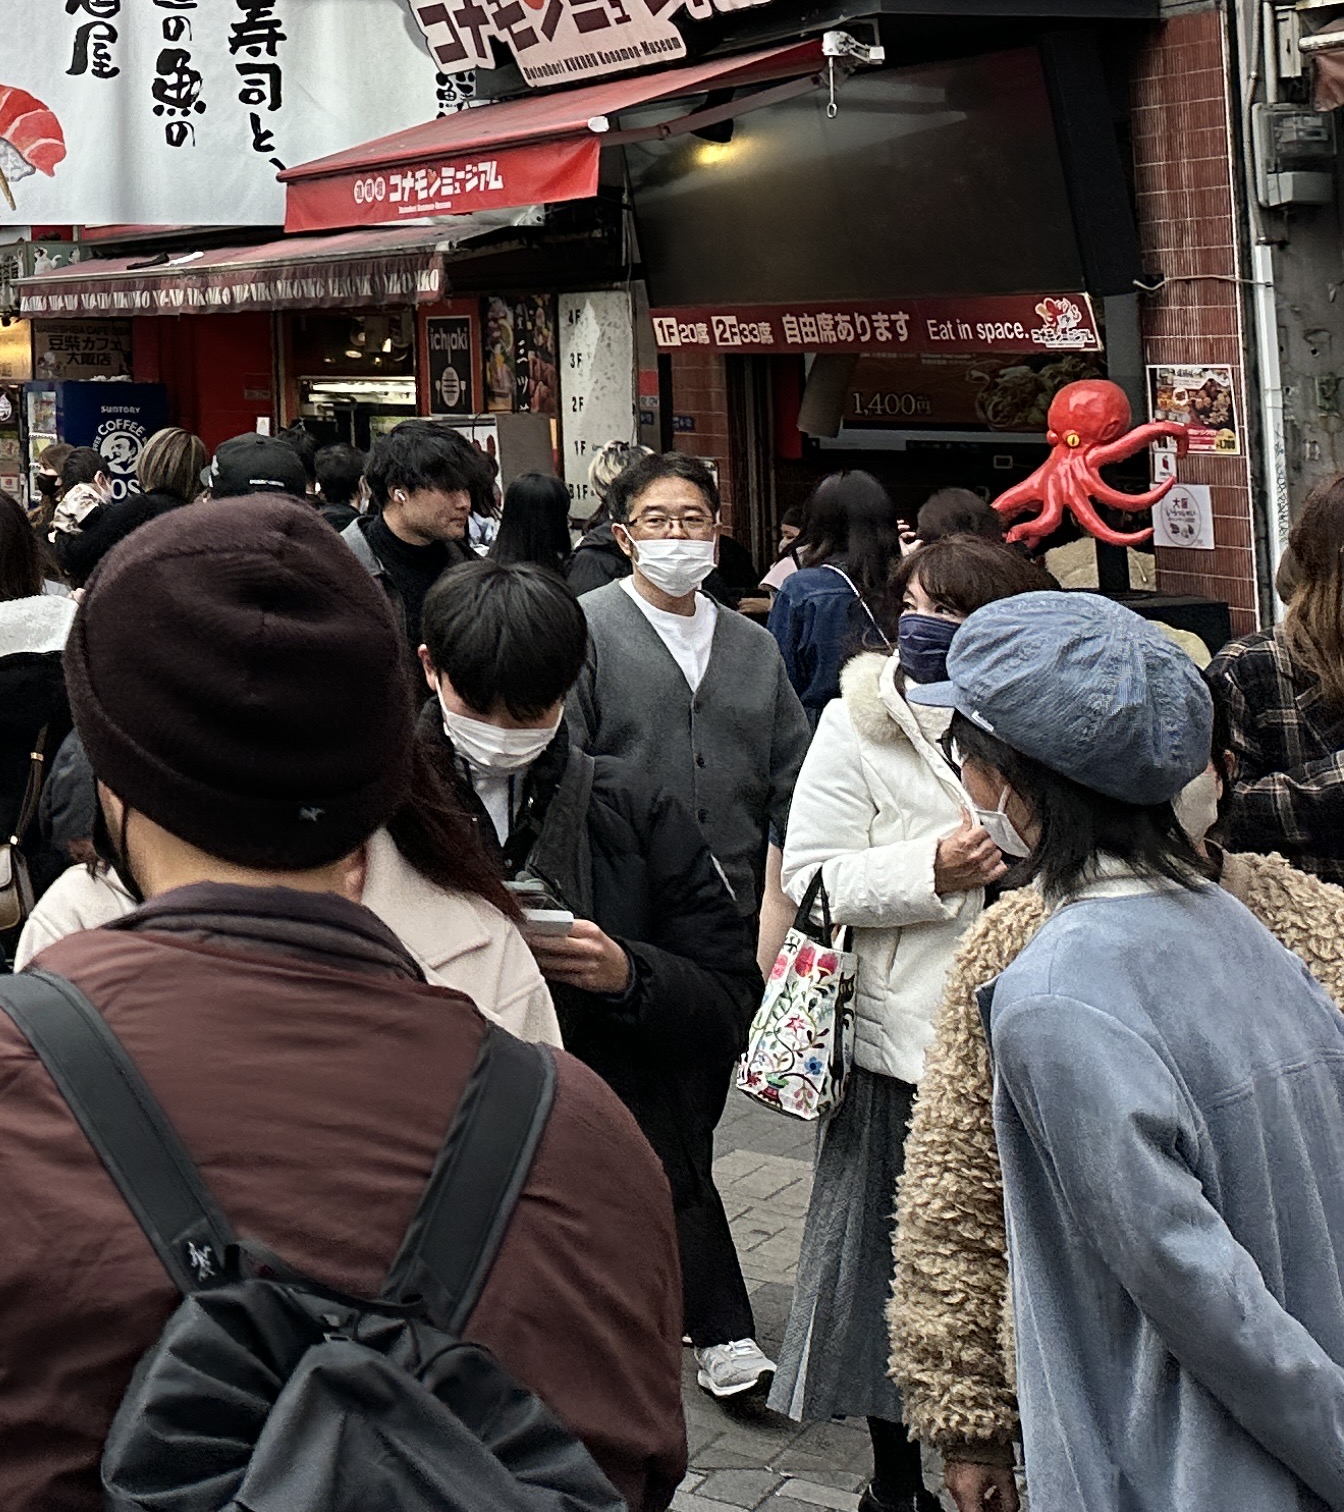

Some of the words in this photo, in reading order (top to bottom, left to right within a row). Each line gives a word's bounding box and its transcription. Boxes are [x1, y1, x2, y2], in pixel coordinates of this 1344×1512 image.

[389, 160, 504, 203] コナモンミュージアム
[568, 309, 582, 324] 4F
[782, 311, 910, 345] 自由席あります
[927, 318, 955, 342] Eat
[957, 318, 973, 341] in
[977, 316, 1030, 343] space.
[66, 351, 112, 367] 大阪店
[570, 352, 583, 369] 3F
[100, 406, 142, 414] SUNTORY
[571, 396, 584, 413] 2F
[852, 391, 933, 416] 1,400円
[97, 418, 145, 437] COFFEE
[574, 440, 587, 456] 1F
